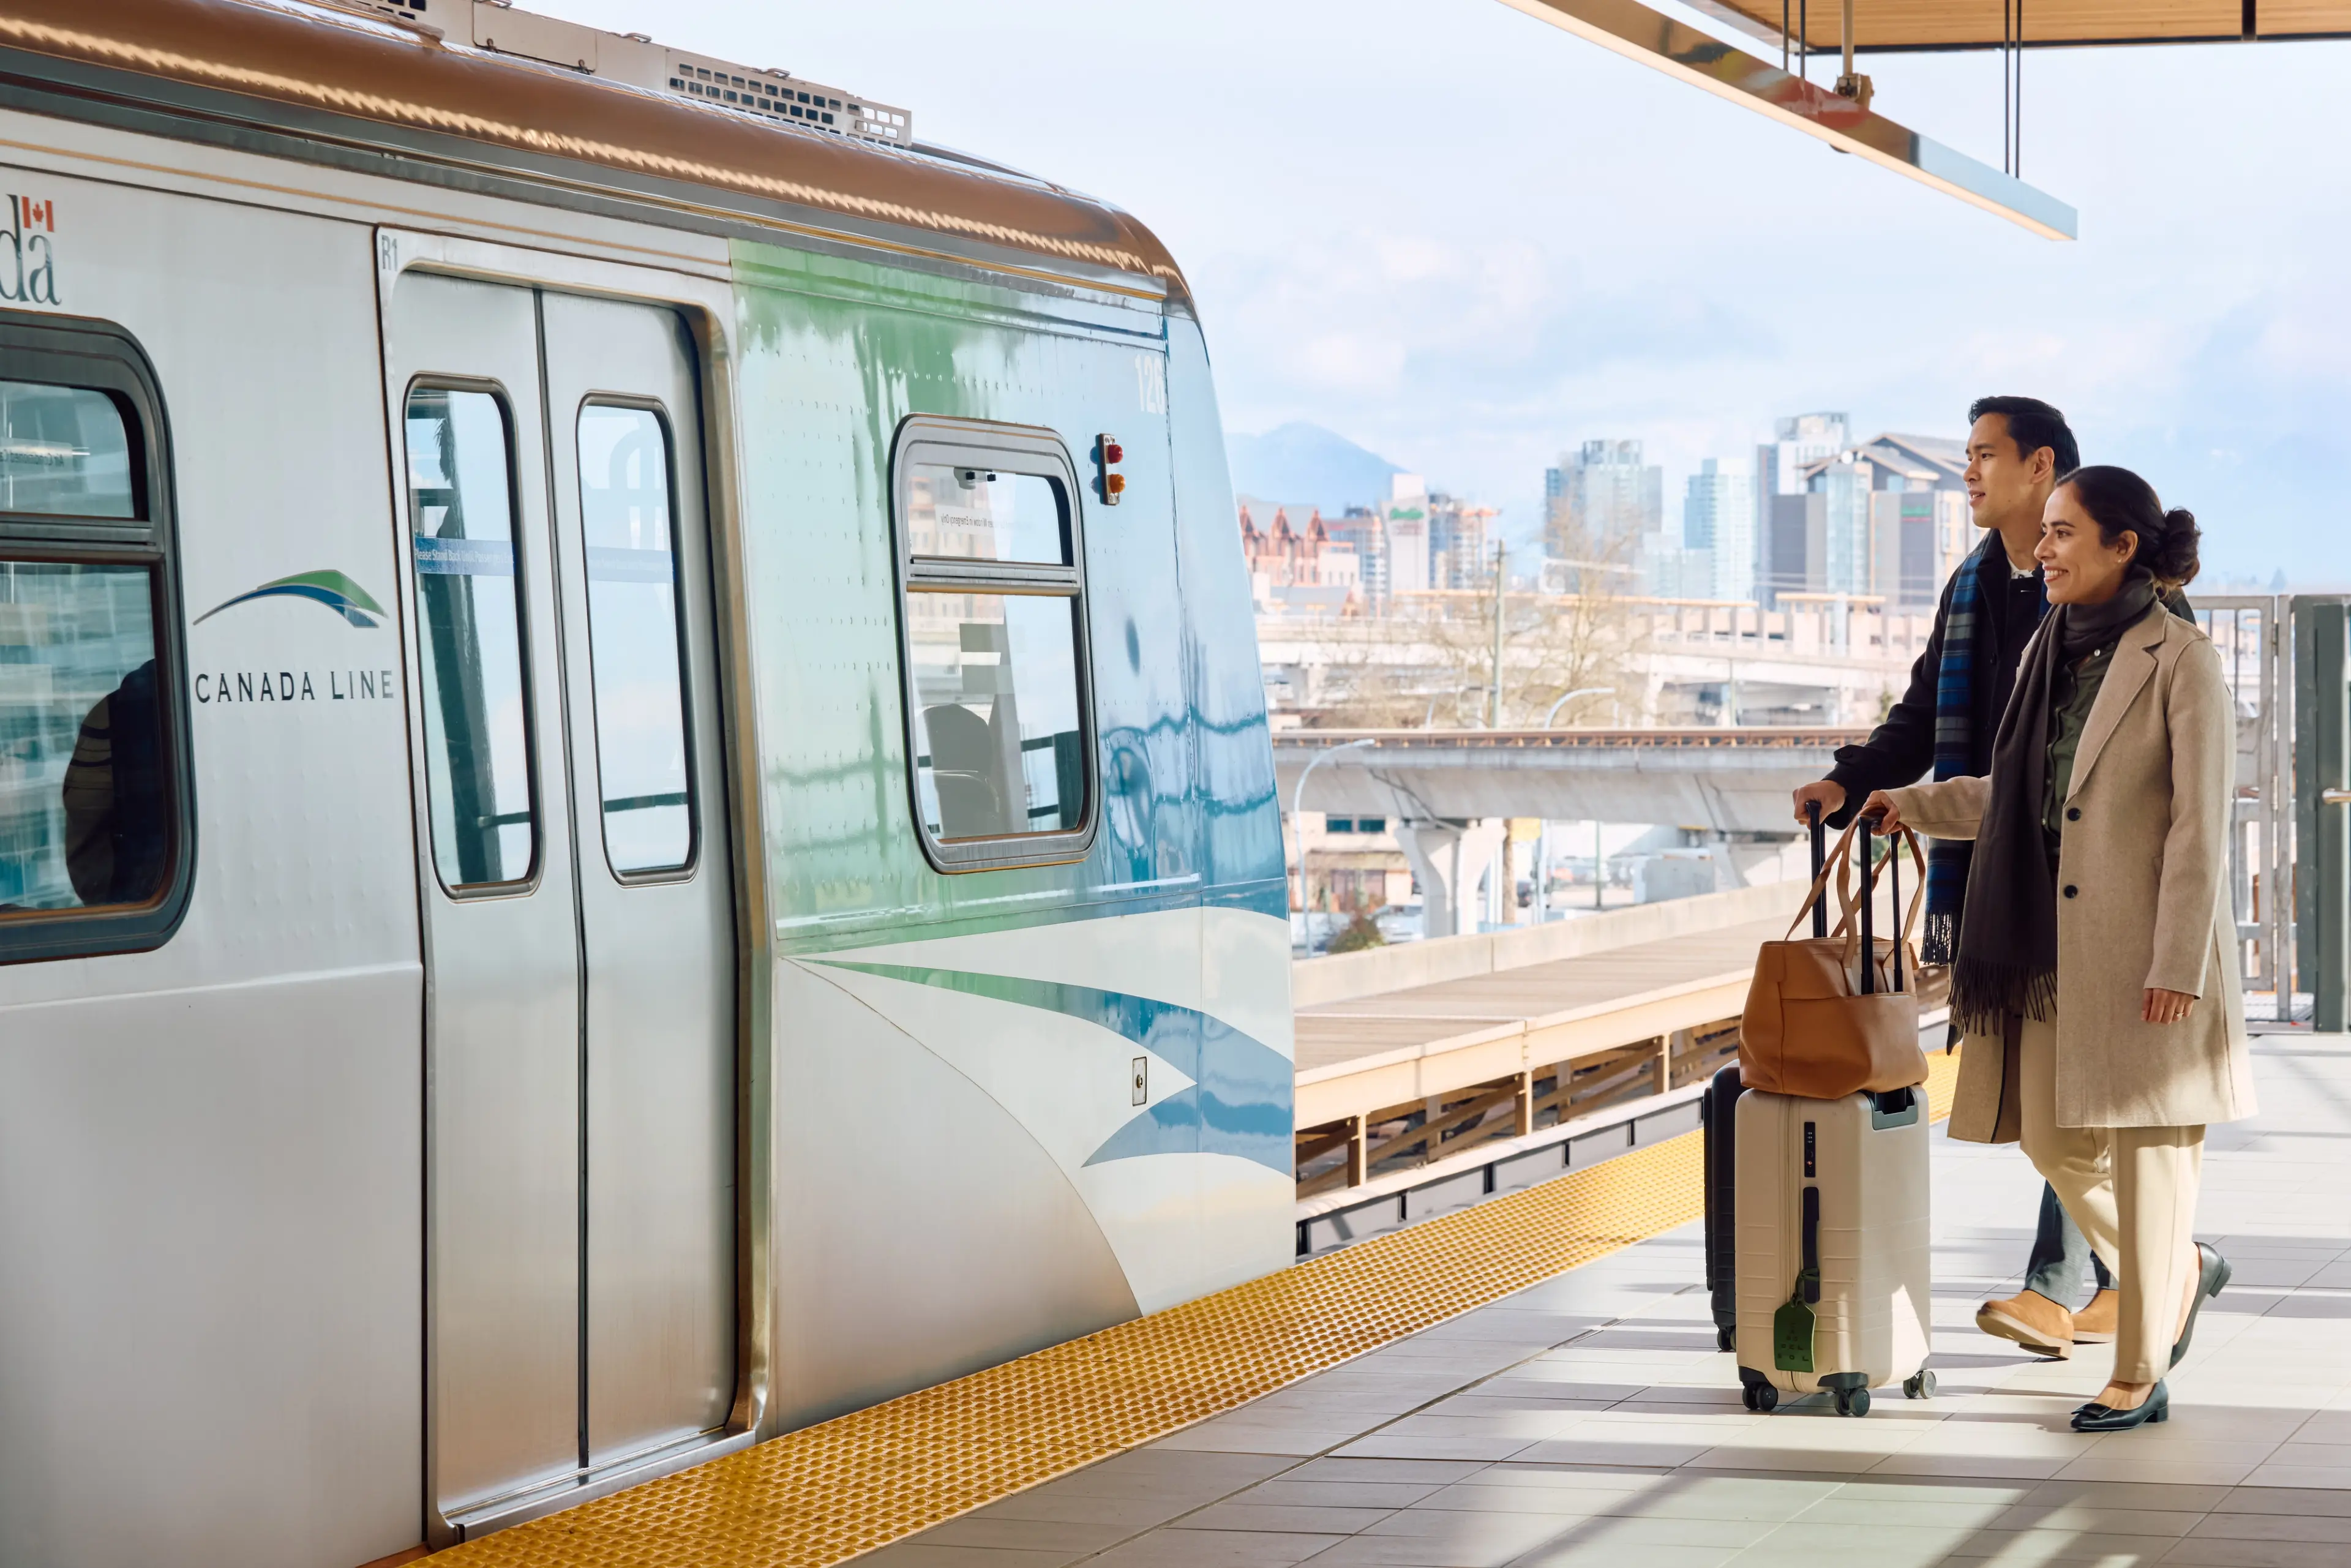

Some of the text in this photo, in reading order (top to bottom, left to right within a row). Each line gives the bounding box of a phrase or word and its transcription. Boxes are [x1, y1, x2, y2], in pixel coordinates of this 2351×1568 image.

[381, 234, 398, 272] R1
[1134, 354, 1166, 415] 126
[414, 547, 432, 560] Please
[432, 549, 448, 561] Stand
[448, 549, 461, 561] Back
[195, 670, 395, 703] CANADA LINE
